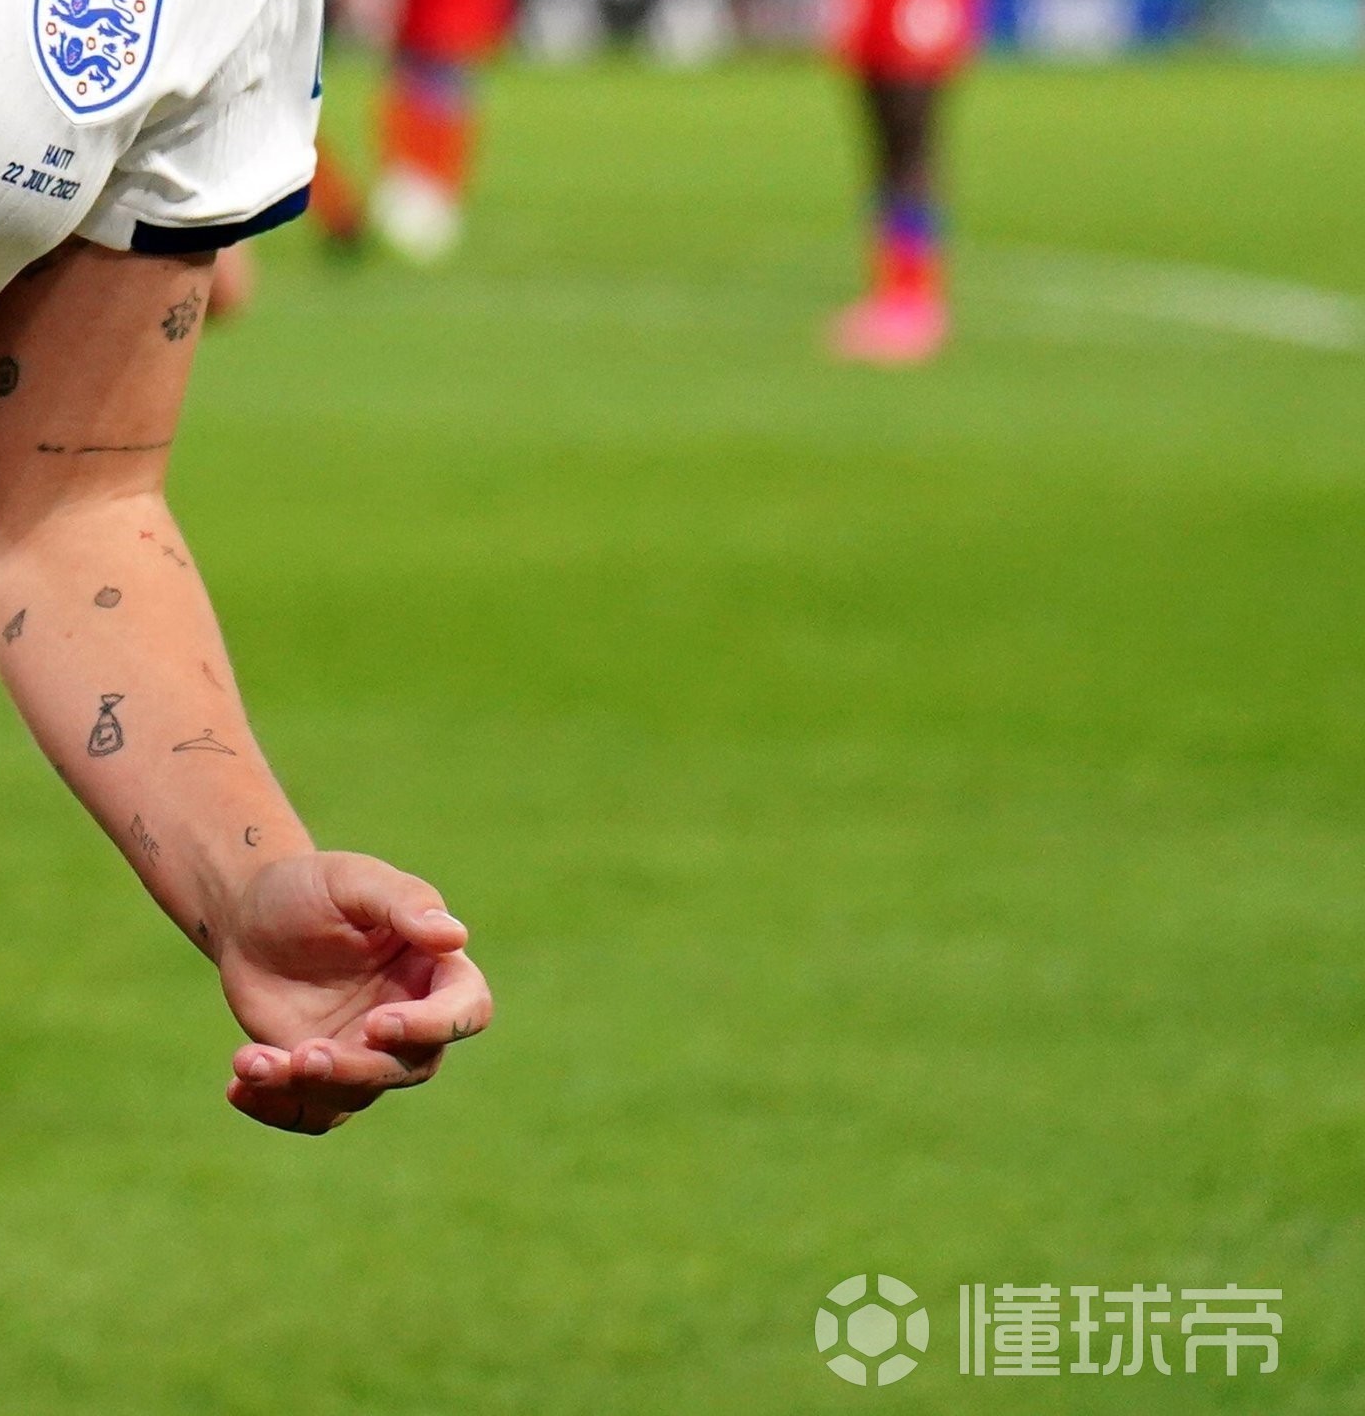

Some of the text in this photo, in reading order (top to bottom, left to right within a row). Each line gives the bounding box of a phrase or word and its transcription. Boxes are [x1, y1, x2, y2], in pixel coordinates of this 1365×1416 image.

[42, 145, 74, 169] HAITI
[1, 162, 80, 200] 22 JULY 2023
